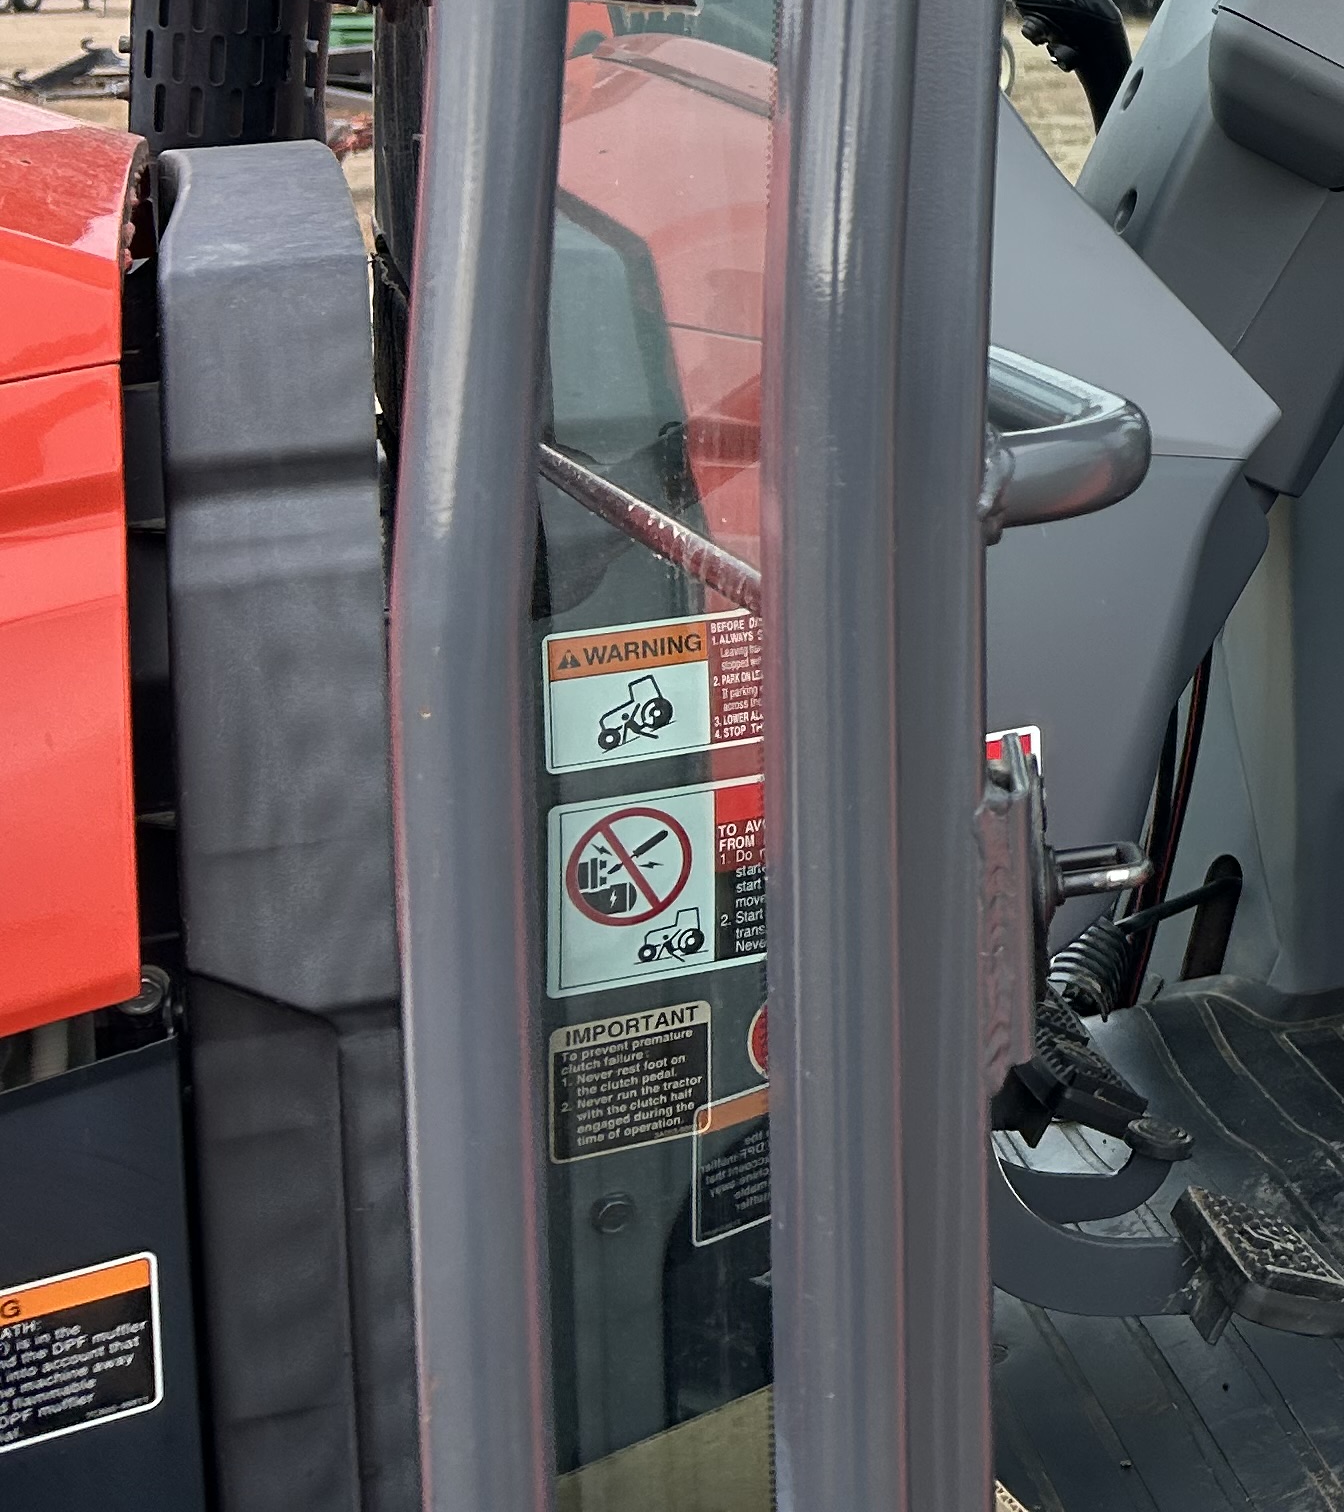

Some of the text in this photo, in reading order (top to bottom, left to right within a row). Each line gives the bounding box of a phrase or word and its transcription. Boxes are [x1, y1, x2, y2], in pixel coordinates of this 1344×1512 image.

[711, 619, 744, 633] BEFORE
[720, 631, 754, 644] ALWAYS
[583, 633, 702, 665] WARNING
[722, 673, 740, 685] PARK
[723, 712, 749, 725] LOWER
[724, 725, 746, 738] STOP
[718, 824, 737, 837] TO
[719, 834, 755, 852] FROM
[736, 850, 752, 862] Do
[736, 878, 761, 893] start
[736, 908, 763, 924] Start
[566, 1005, 698, 1047] IMPORTANT
[561, 1029, 694, 1062] To prevent premature
[561, 1058, 601, 1075] clutch
[576, 1069, 613, 1084] Never
[617, 1064, 640, 1076] rest
[643, 1057, 667, 1071] foot
[671, 1055, 686, 1064] on
[577, 1067, 677, 1097] the clutch pedal.
[577, 1094, 613, 1109] Never
[617, 1089, 637, 1100] run
[641, 1083, 660, 1096] the
[663, 1075, 703, 1090] tractor
[576, 1088, 694, 1121] with the clutch half
[576, 1102, 695, 1134] engaged during the
[576, 1134, 604, 1146] time
[608, 1129, 621, 1139] of
